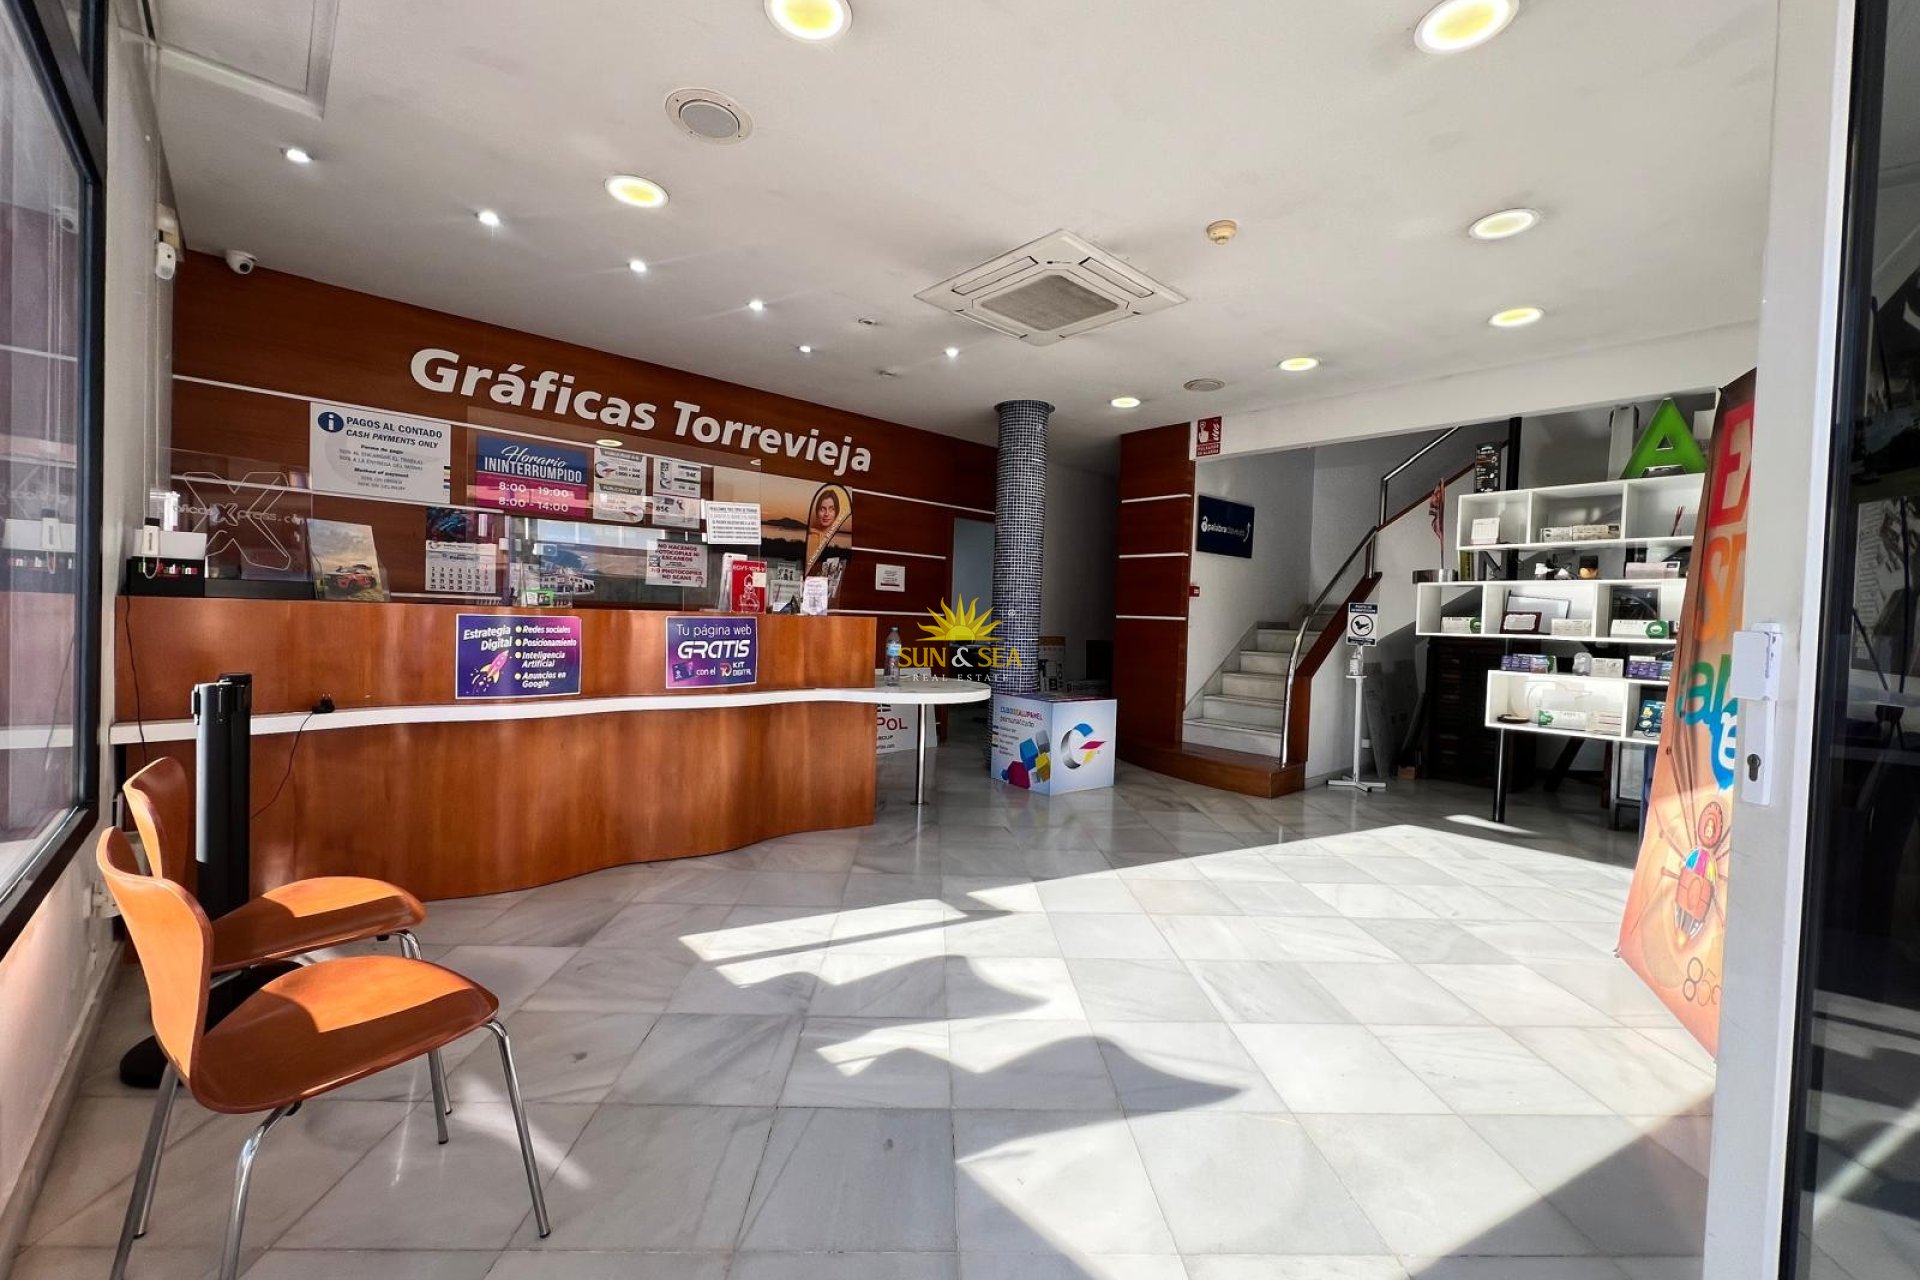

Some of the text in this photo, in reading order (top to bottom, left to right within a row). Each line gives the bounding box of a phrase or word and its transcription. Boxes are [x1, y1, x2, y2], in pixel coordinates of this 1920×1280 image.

[409, 348, 873, 477] Gráficas Torrevieja
[346, 416, 443, 439] PAGOS AL CONTADO
[346, 429, 439, 449] CASH PAYMENTS ONLY
[501, 445, 567, 468] Horario
[484, 456, 582, 483] ININTERRUMPIDO
[498, 482, 526, 492] 8:00
[538, 486, 569, 497] 19:00
[498, 496, 526, 508] 8:00
[537, 500, 569, 512] 14:00
[463, 624, 511, 640] Estrategia
[522, 625, 571, 634] Redes sociales
[676, 624, 752, 638] Tu página web
[481, 636, 513, 651] Digital
[522, 638, 577, 646] Posicionamiento
[678, 640, 751, 658] GRATIS
[522, 651, 566, 661] Inteligencia
[522, 660, 556, 668] Artificial
[696, 668, 709, 676] con
[710, 666, 716, 676] el
[522, 672, 556, 680] Anuncios
[522, 680, 550, 688] Google
